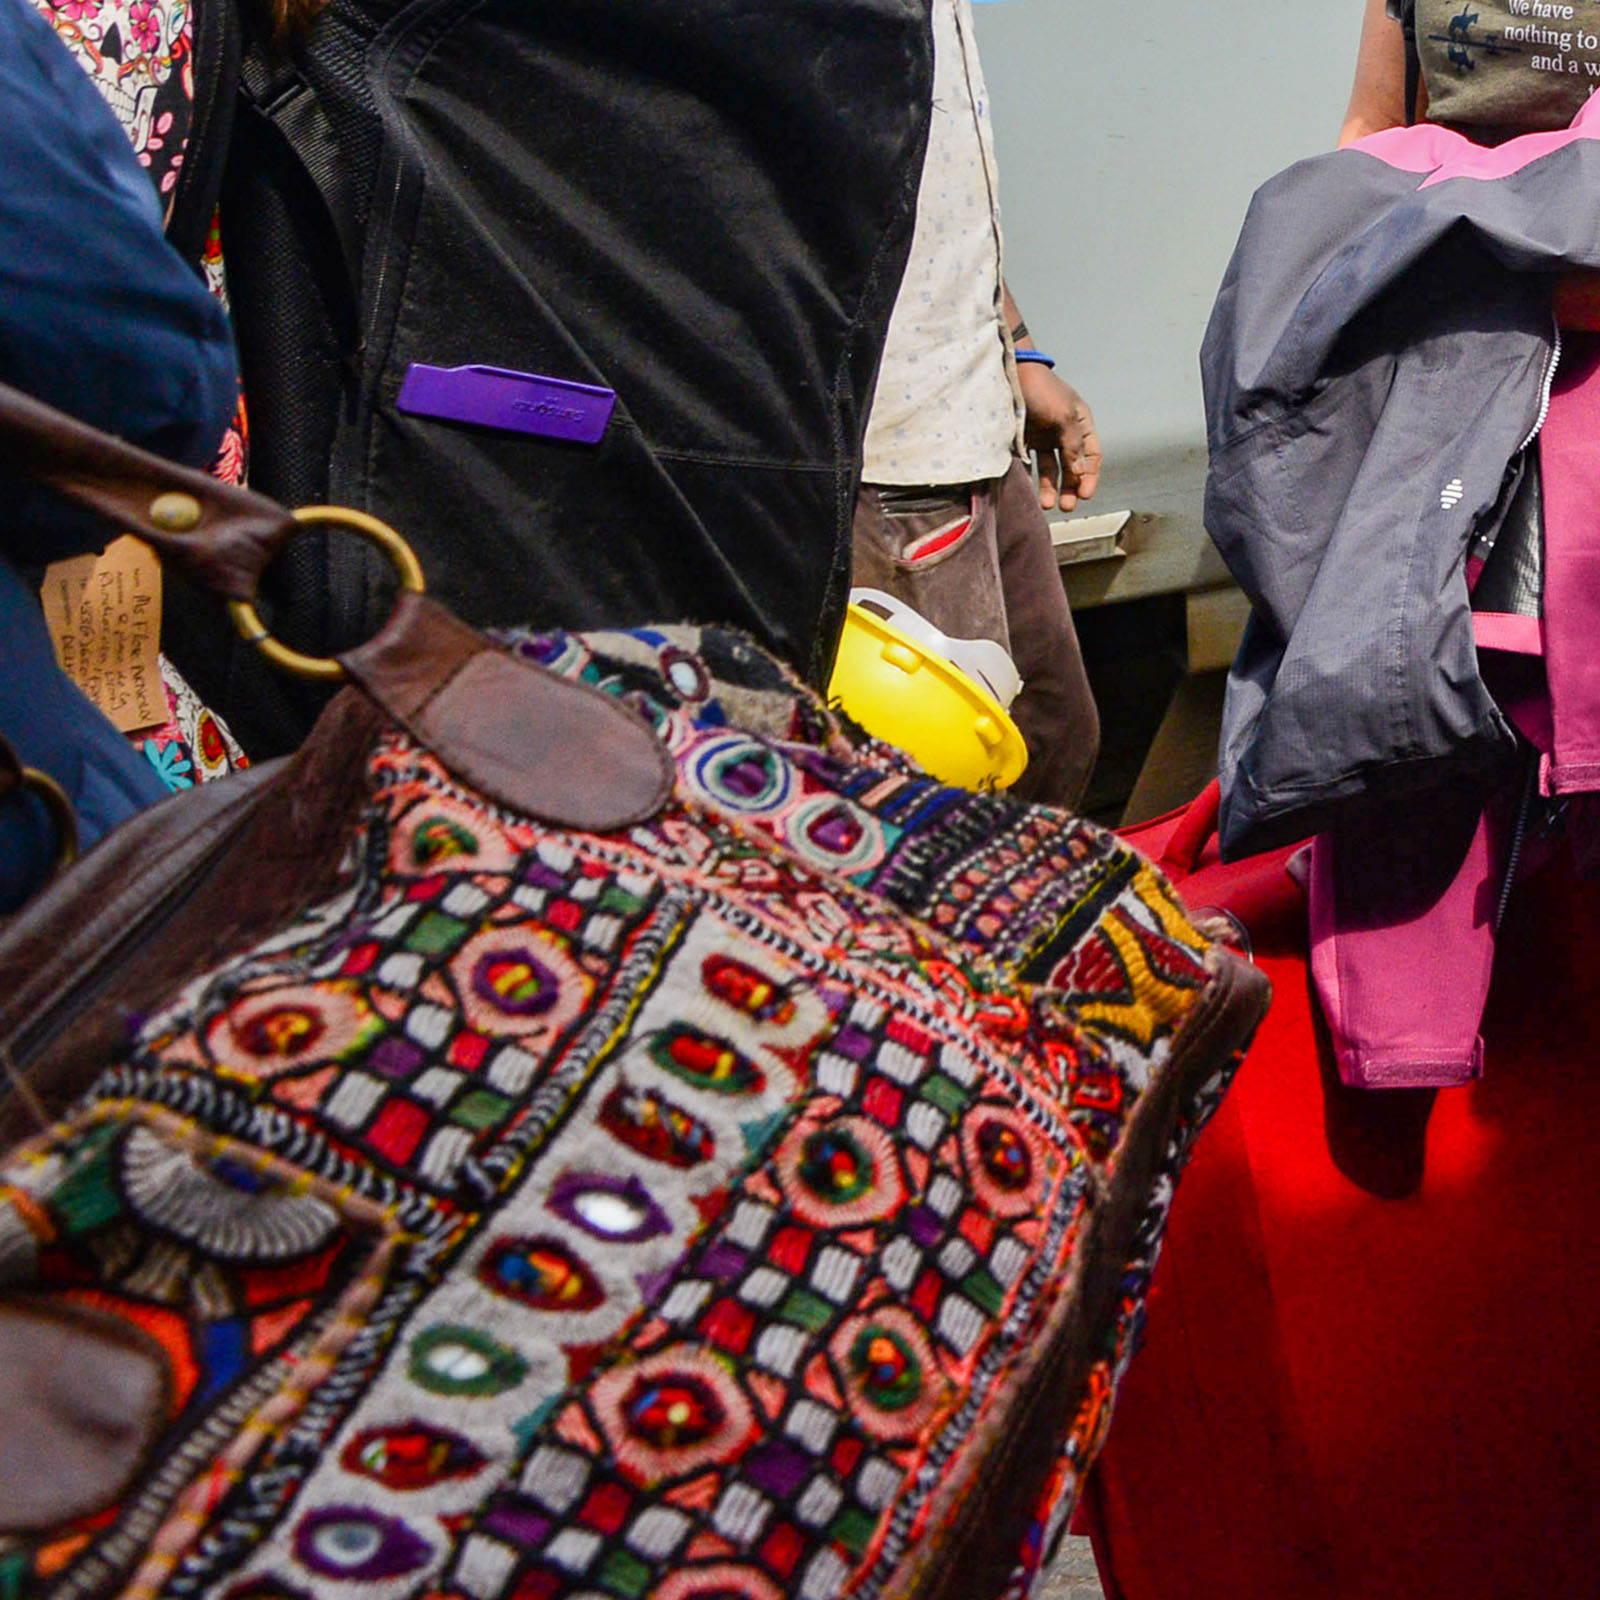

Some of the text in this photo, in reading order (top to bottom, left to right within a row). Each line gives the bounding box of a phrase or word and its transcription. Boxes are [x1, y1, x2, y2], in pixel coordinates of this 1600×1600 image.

[1504, 24, 1572, 53] nothing
[1576, 30, 1598, 51] to
[1531, 54, 1564, 73] and
[1568, 60, 1579, 74] a
